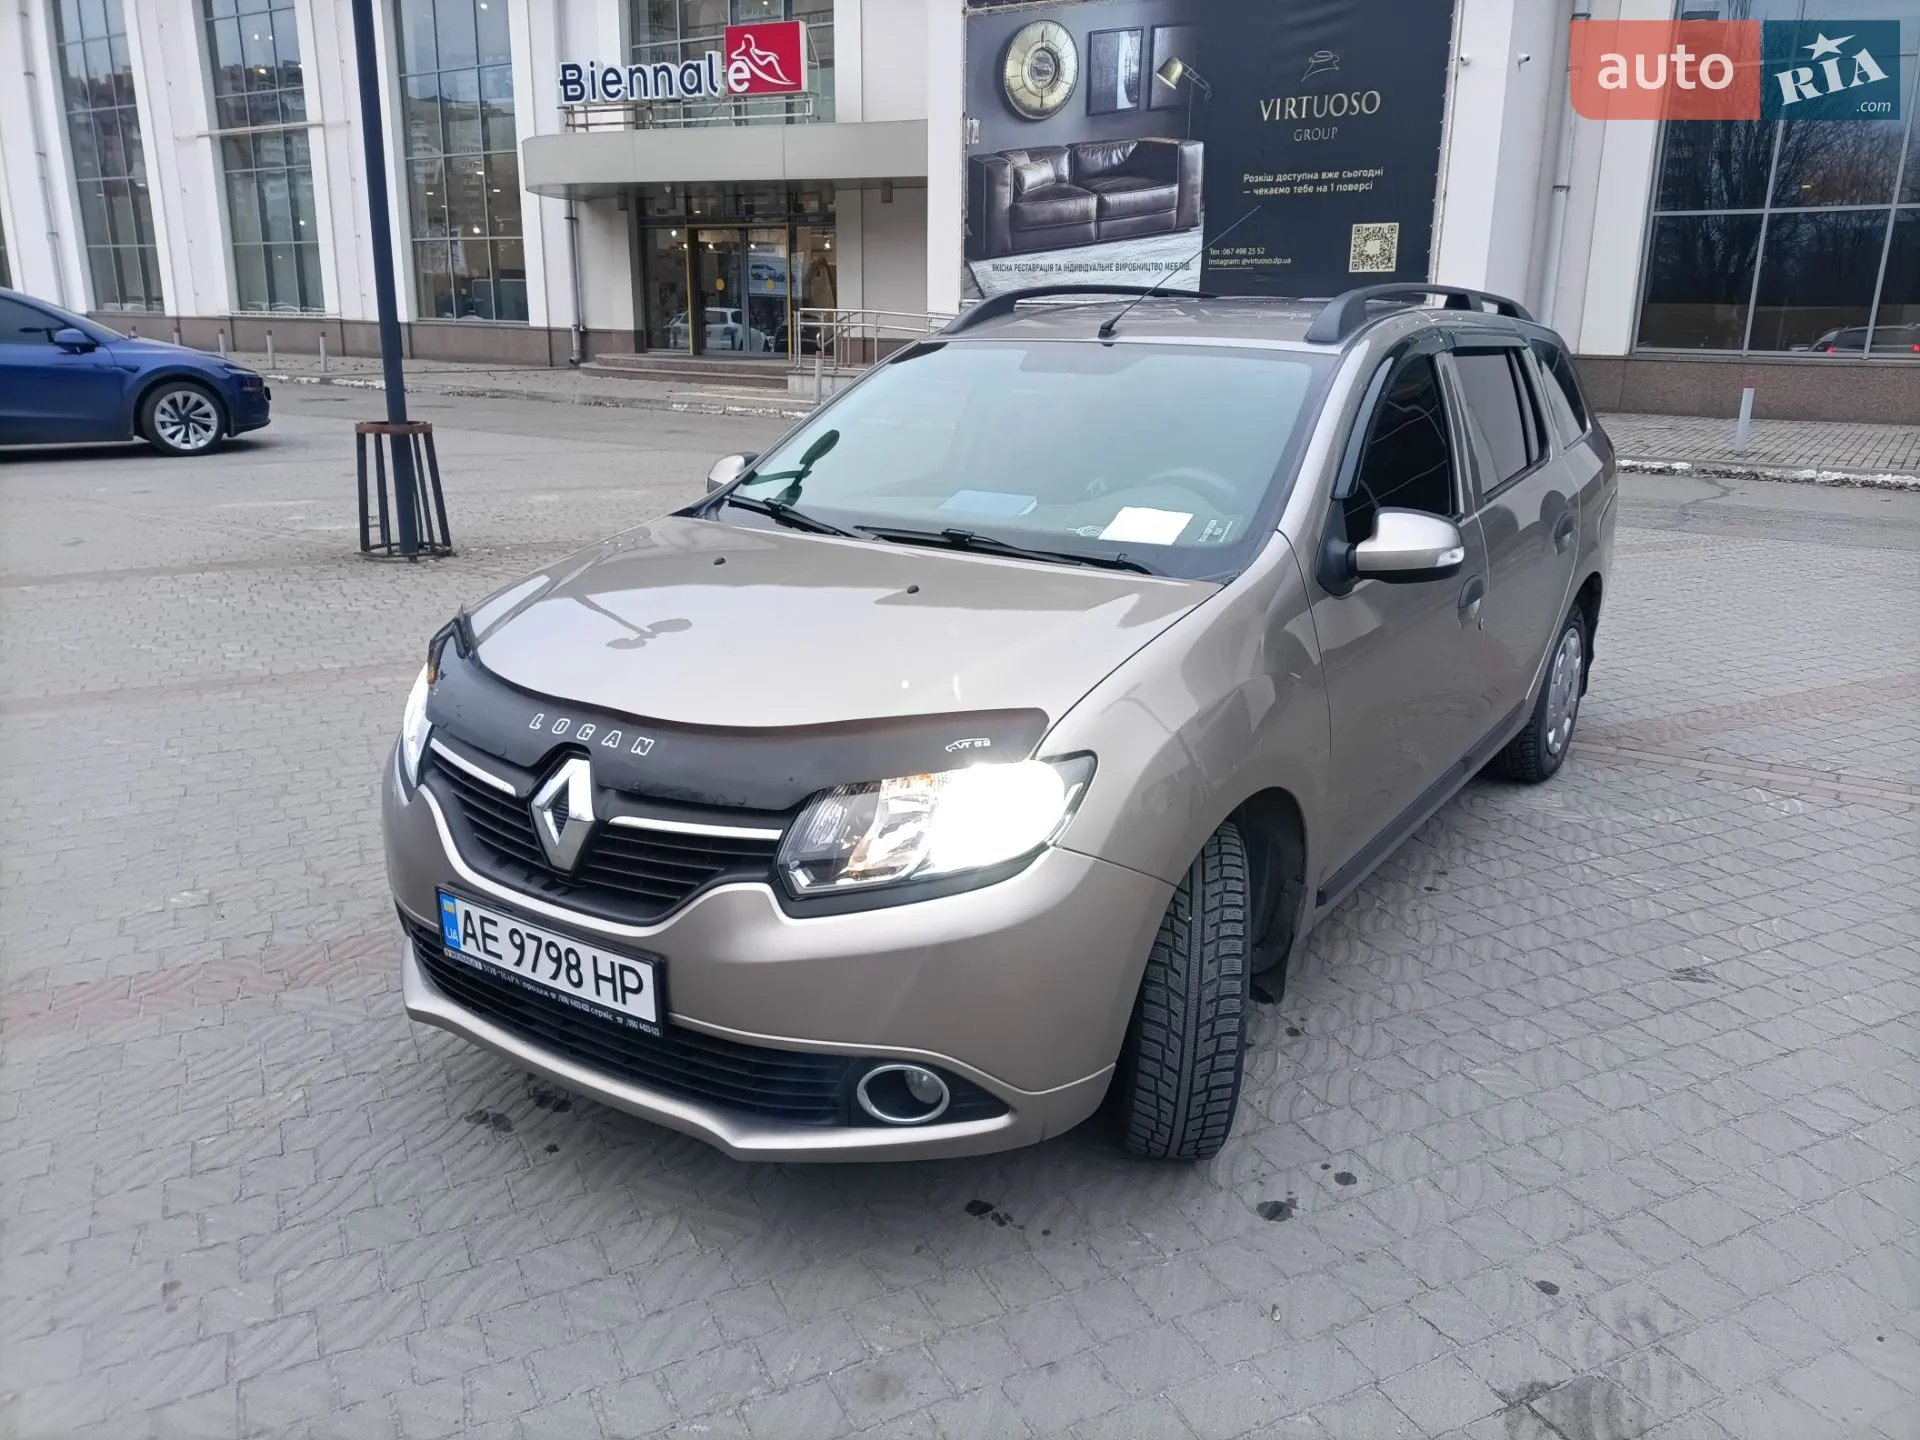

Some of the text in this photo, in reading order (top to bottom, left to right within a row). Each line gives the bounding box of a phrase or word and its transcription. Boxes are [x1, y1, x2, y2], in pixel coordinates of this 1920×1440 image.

[559, 51, 751, 104] Biennale
[1260, 90, 1381, 121] VIRTUOSO
[1293, 127, 1338, 142] GROUP
[1243, 166, 1384, 183] Розкіш доступна вже сьогодні
[1253, 186, 1291, 195] чекаємо
[1293, 184, 1314, 193] тебе
[1316, 184, 1328, 192] на
[1330, 182, 1335, 191] 1
[1336, 180, 1373, 191] поверсі
[991, 263, 1013, 273] ЯКІСНА
[1014, 263, 1054, 273] РЕСТАВРАЦІЯ
[1063, 262, 1114, 273] ІНДИВІДУАЛЬНЕ
[1115, 261, 1163, 272] ВИРОБНИЦТВО
[1208, 256, 1292, 266] Instagram: @virtuoso.dp.ua
[529, 713, 654, 756] LOGAN
[446, 926, 459, 943] UA
[462, 909, 503, 961] AE
[508, 927, 583, 989] 9798
[592, 955, 643, 1006] HP
